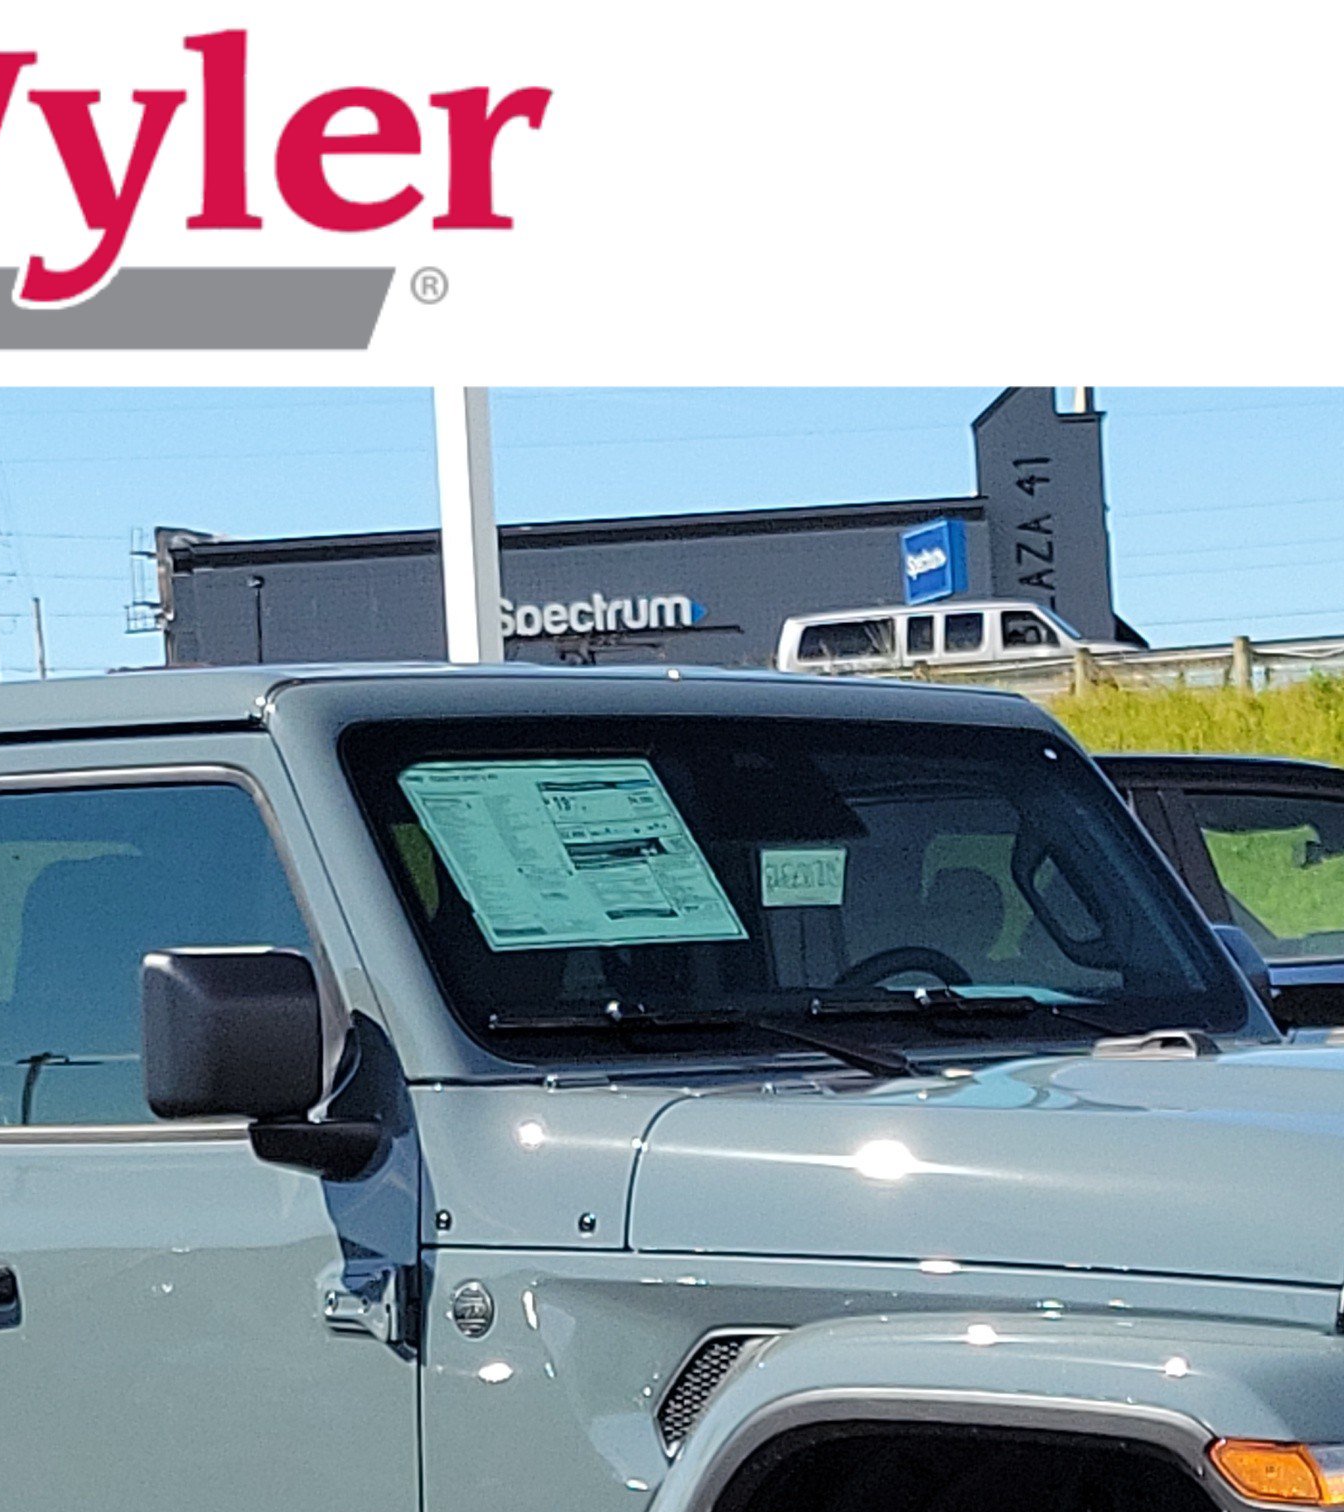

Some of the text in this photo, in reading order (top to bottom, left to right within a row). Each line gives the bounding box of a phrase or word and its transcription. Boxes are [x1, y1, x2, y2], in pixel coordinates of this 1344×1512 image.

[1012, 457, 1056, 611] AZA 41
[498, 593, 693, 637] Spectrum
